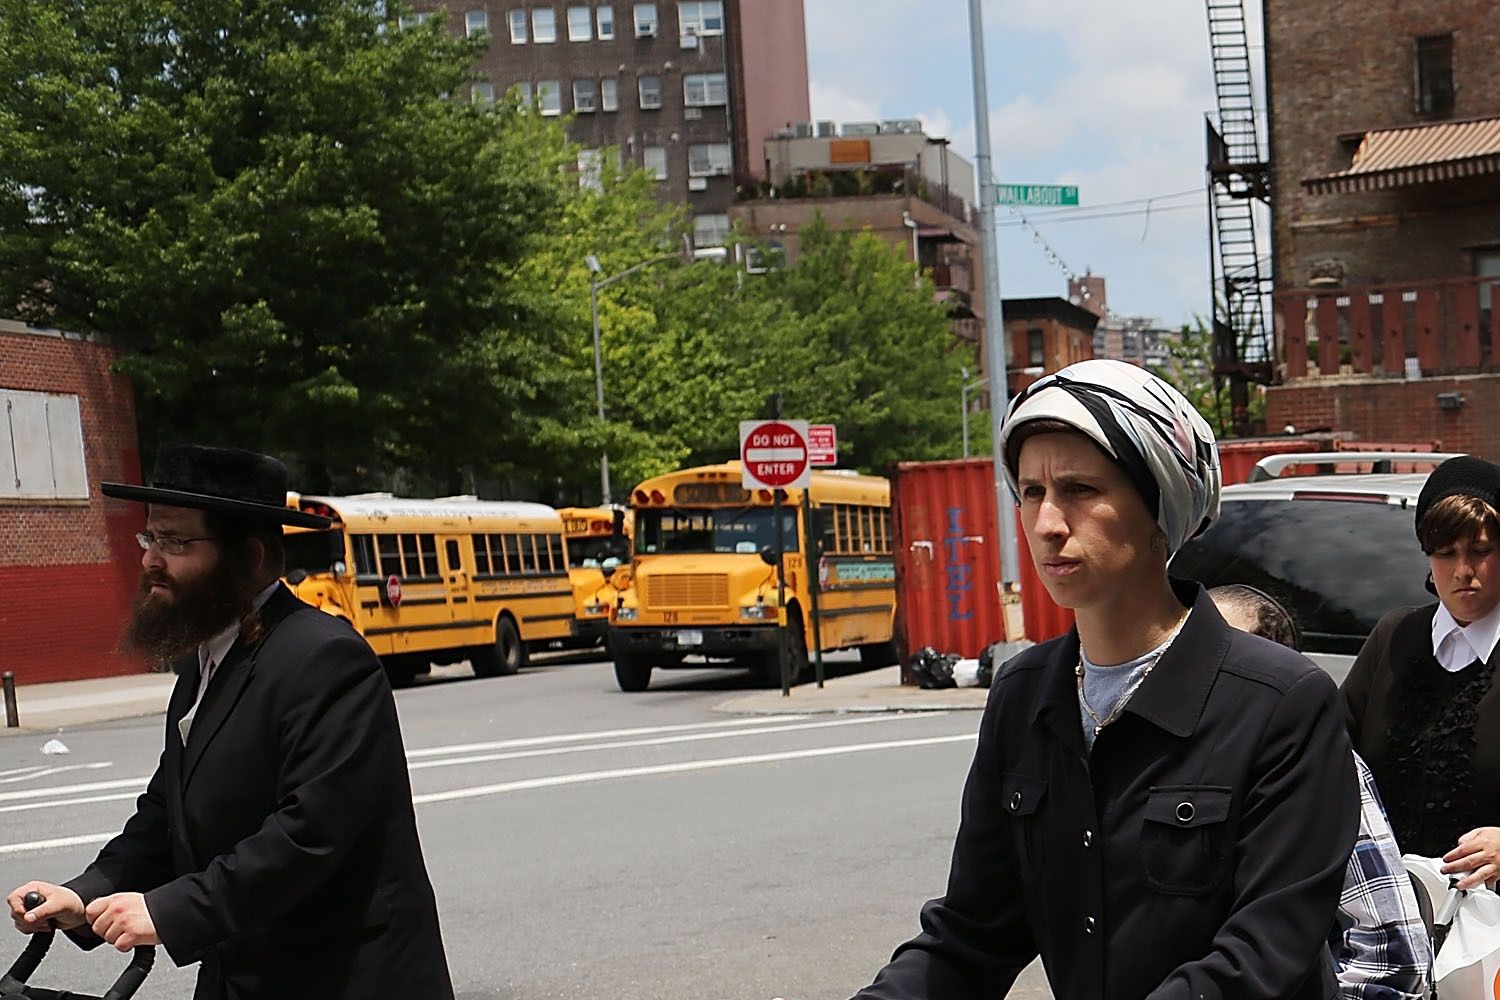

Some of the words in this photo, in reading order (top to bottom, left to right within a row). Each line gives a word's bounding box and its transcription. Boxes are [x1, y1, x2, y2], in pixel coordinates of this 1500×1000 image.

[997, 186, 1062, 205] WALLABOUT
[753, 434, 769, 446] DO
[773, 433, 796, 446] NOT
[757, 463, 795, 476] ENTER
